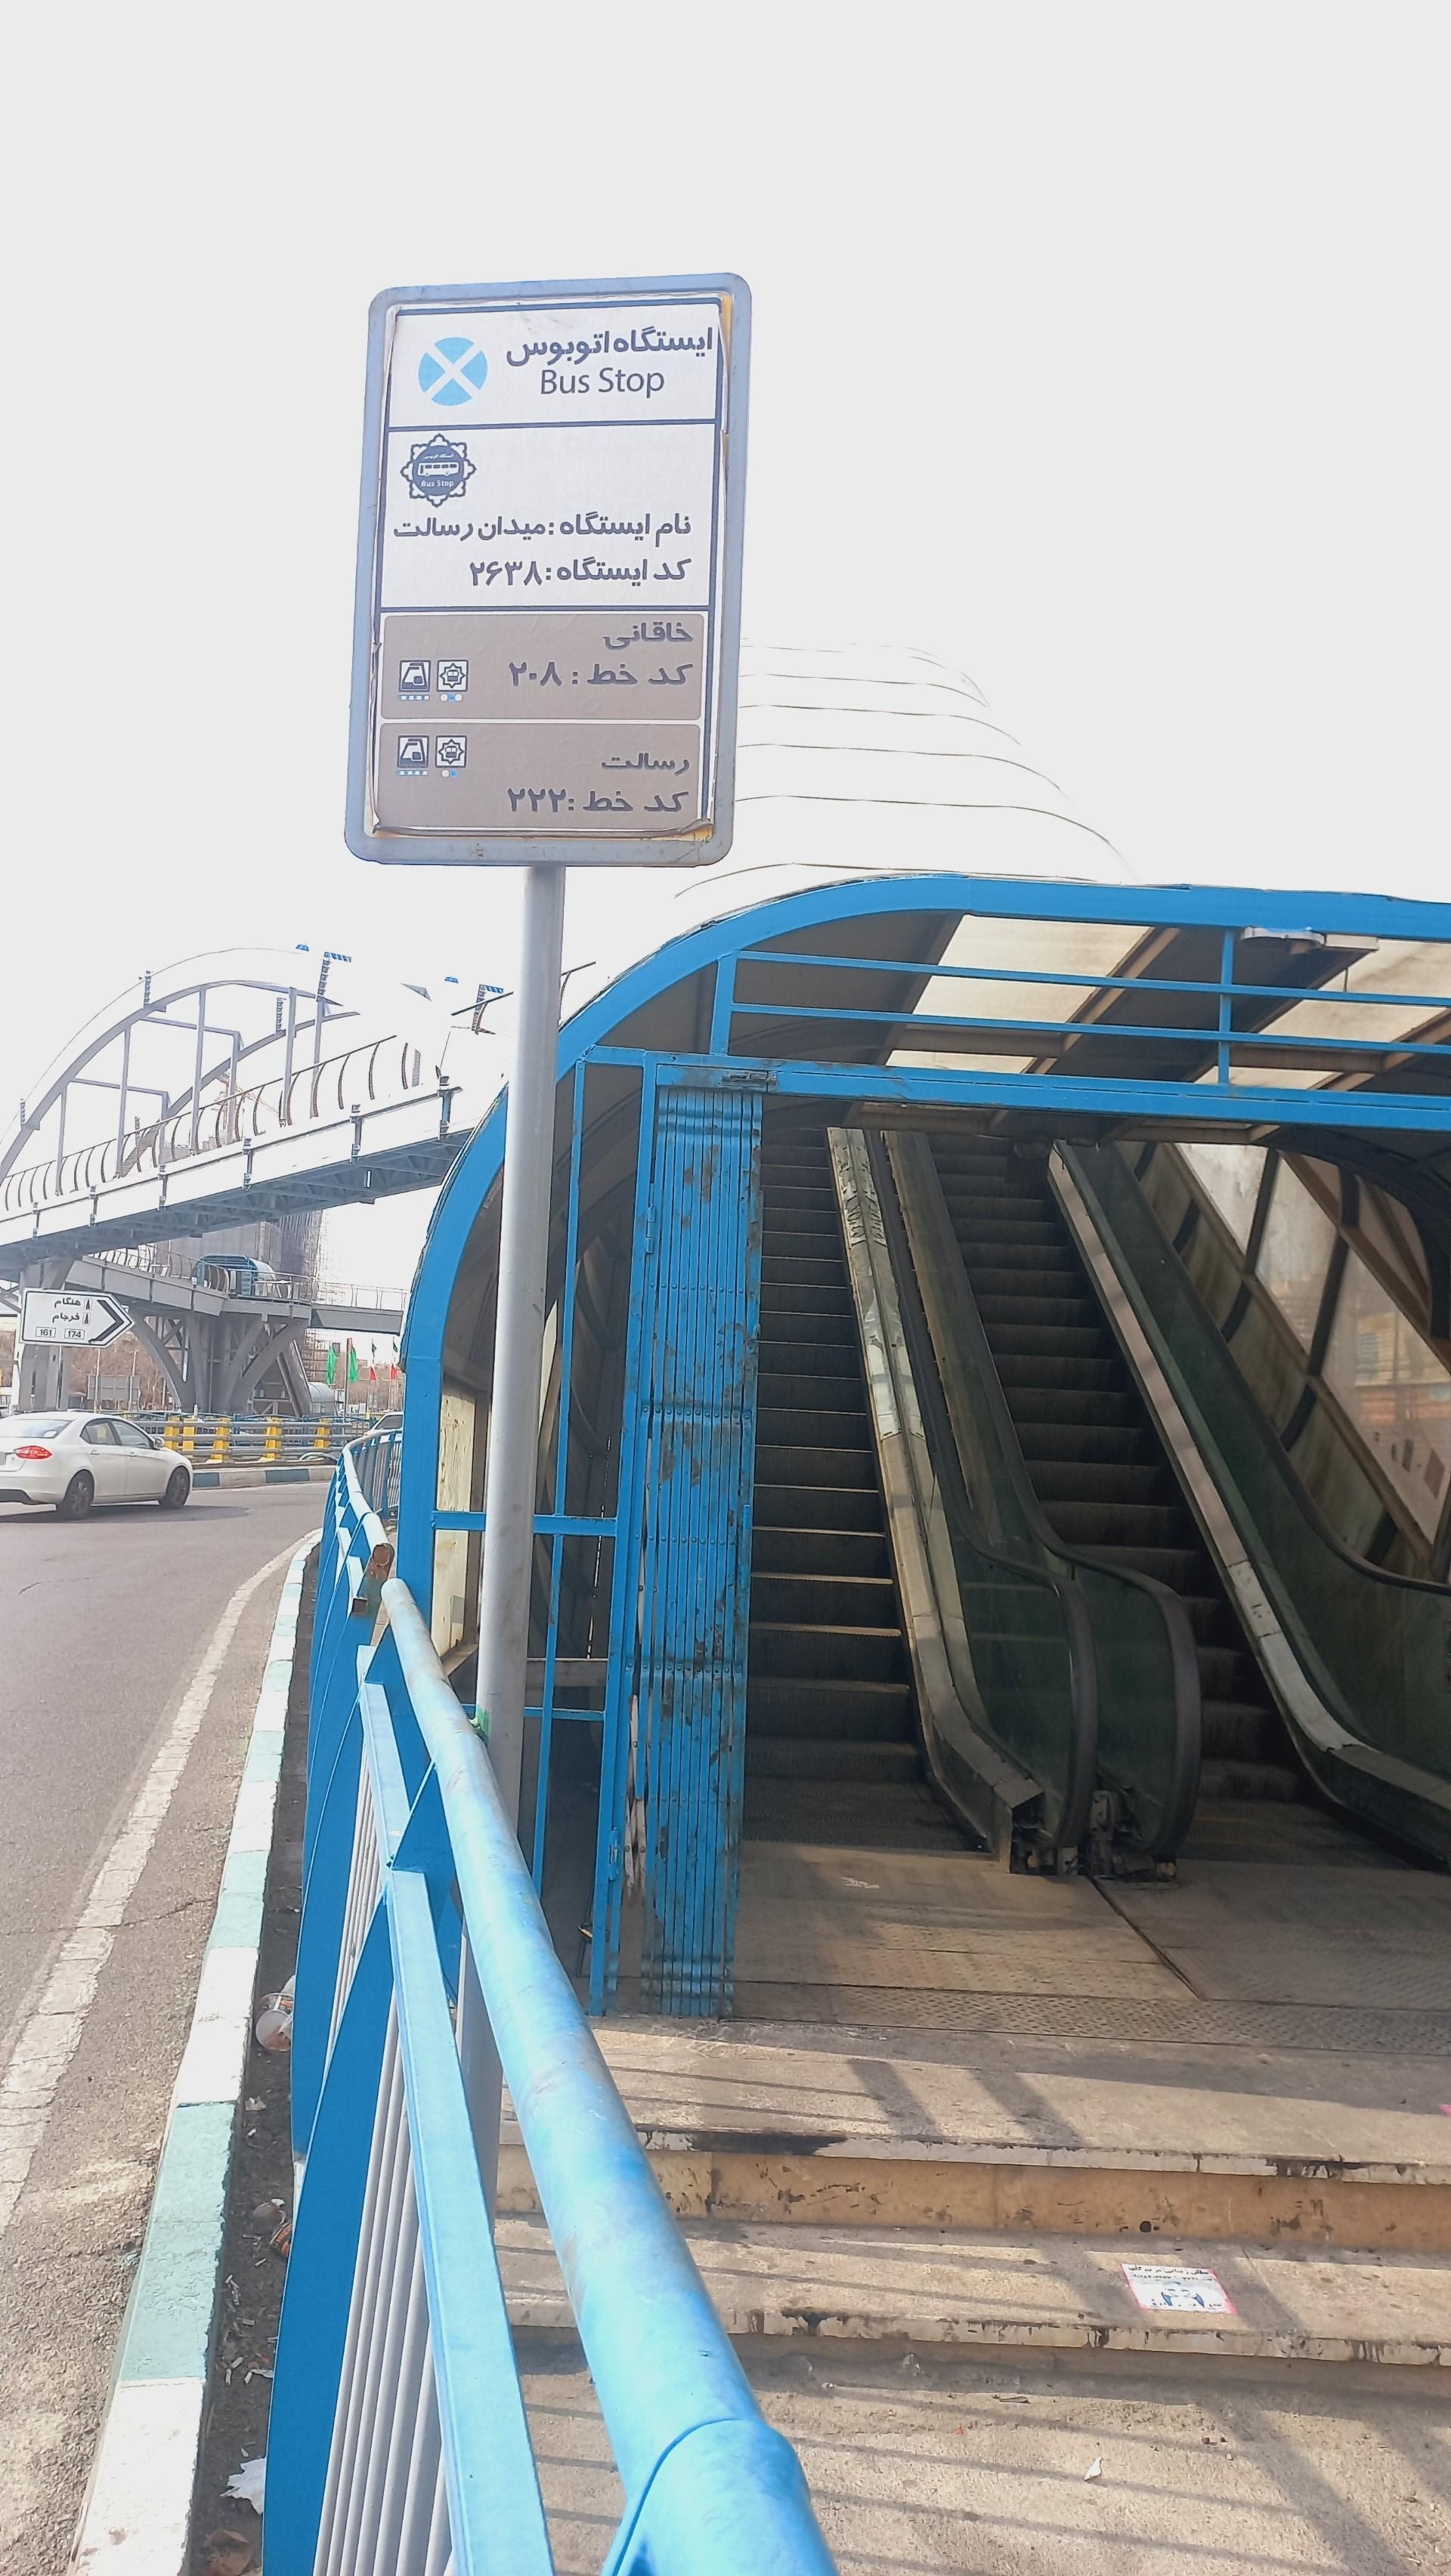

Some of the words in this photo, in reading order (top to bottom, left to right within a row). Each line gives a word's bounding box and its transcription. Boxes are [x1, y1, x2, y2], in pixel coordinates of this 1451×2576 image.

[506, 330, 610, 367] اتوبوس
[613, 326, 713, 357] ایستگاه
[540, 369, 590, 394] Bus
[598, 366, 665, 399] Stop
[436, 479, 454, 488] Stop
[393, 517, 474, 542] رسالت
[654, 512, 691, 548] نام
[652, 558, 692, 580] کد
[602, 621, 694, 651] خاقانی
[648, 663, 694, 685] کد
[601, 752, 690, 777] رسالت
[643, 791, 689, 813] کد
[54, 1297, 81, 1309] هنگام
[52, 1312, 80, 1324] فرجام
[39, 1328, 52, 1337] 161
[67, 1330, 82, 1338] 174
